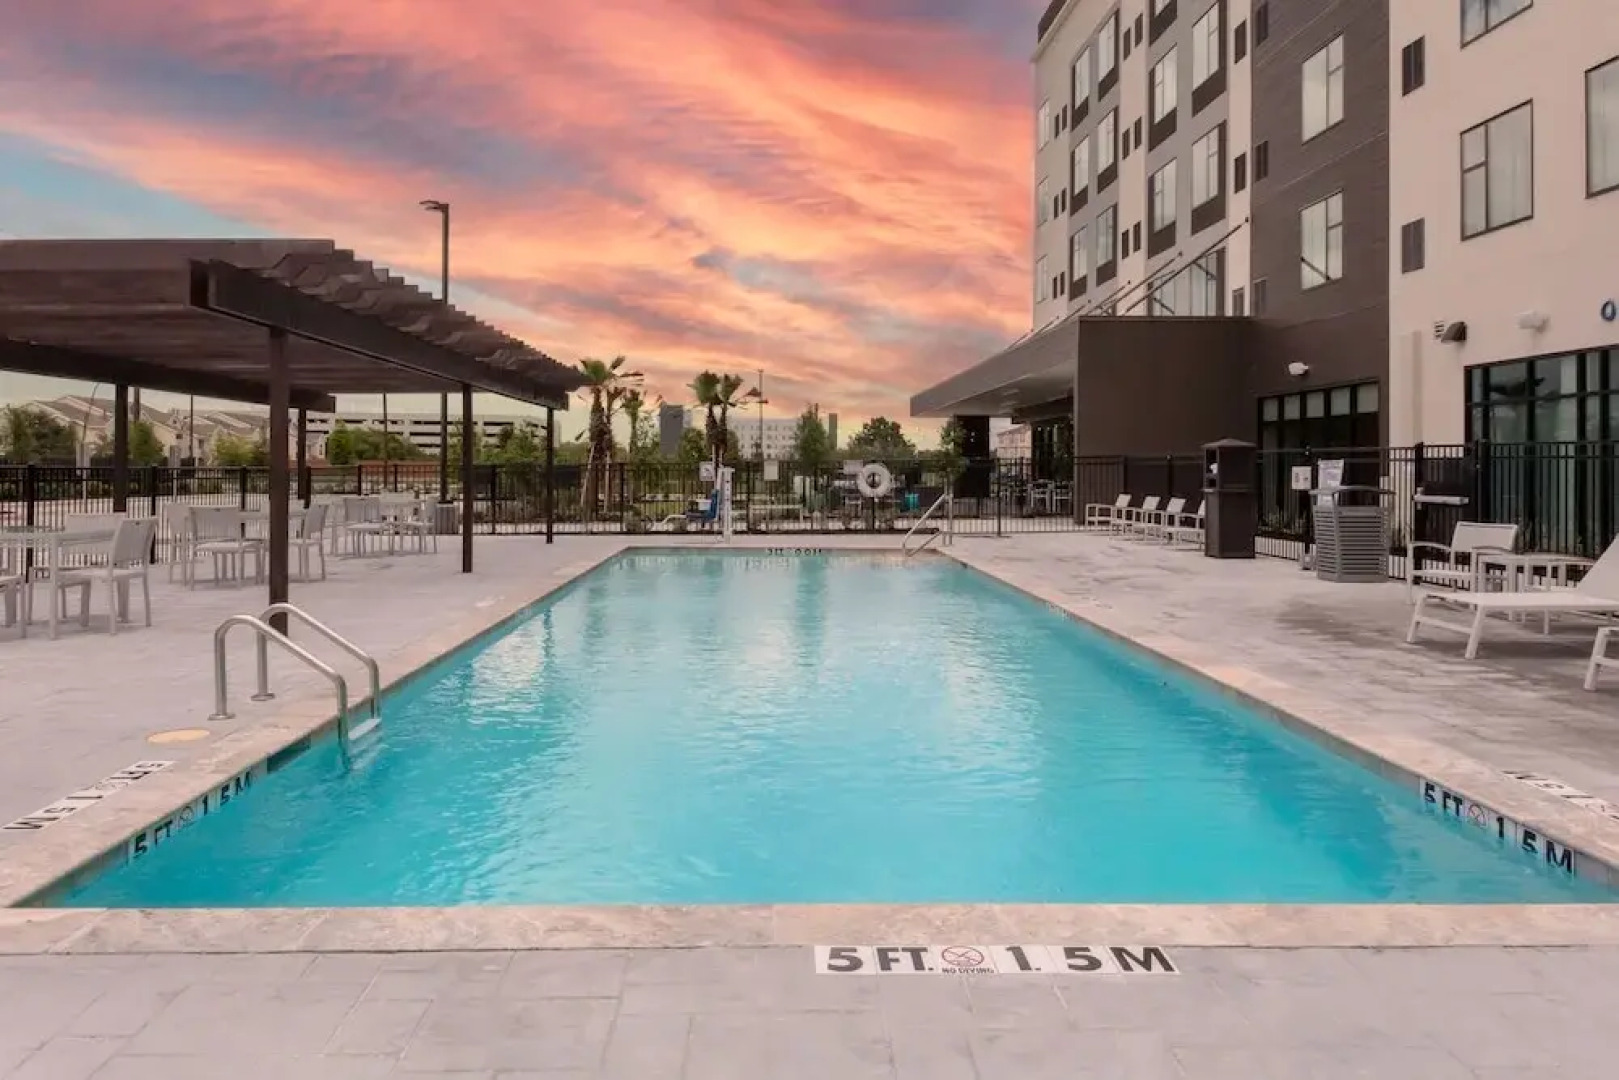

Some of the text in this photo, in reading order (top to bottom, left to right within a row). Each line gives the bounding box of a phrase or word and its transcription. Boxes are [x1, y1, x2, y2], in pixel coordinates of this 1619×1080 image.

[1424, 781, 1437, 803] 5
[1522, 828, 1538, 853] 5
[1545, 839, 1573, 874] M
[133, 833, 148, 859] 5
[827, 946, 864, 972] 5
[876, 946, 934, 972] FT.
[1109, 946, 1176, 973] M
